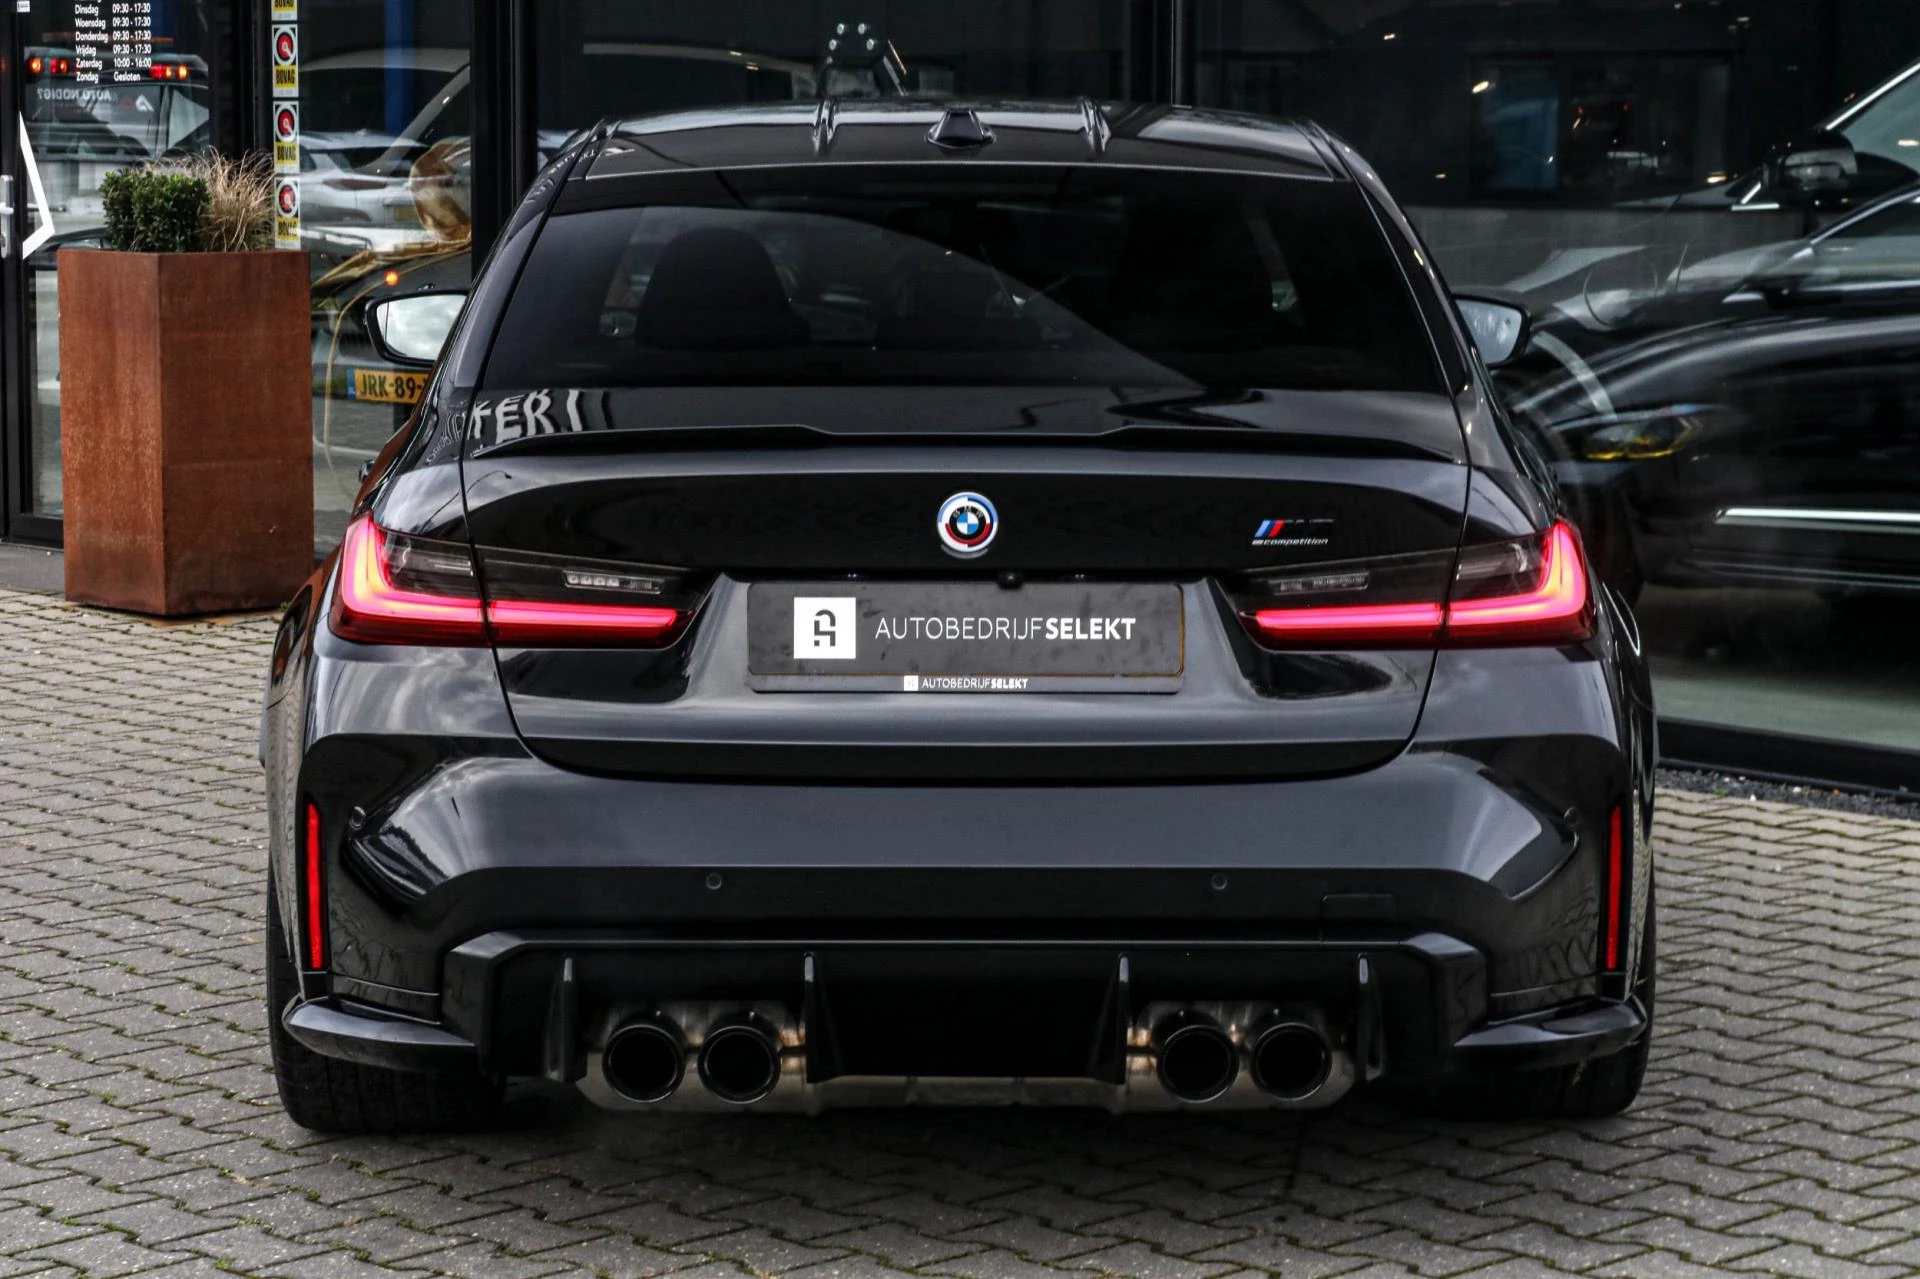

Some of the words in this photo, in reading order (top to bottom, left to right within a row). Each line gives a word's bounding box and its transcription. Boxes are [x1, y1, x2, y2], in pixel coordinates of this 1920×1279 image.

[75, 4, 99, 16] Dinsdag
[112, 3, 129, 14] 09:30
[134, 3, 151, 13] 17:30
[75, 18, 106, 30] Woensdag
[112, 17, 129, 27] 09:30
[134, 17, 151, 27] 17:30
[75, 31, 109, 43] Donderdag
[112, 30, 130, 41] 09:30
[134, 30, 151, 40] 17:30
[75, 44, 97, 57] Vrijdag
[113, 44, 130, 54] 09:30
[135, 44, 152, 54] 17:30
[76, 58, 103, 70] Zaterdag
[113, 58, 130, 68] 10:00
[135, 58, 152, 68] 16:00
[76, 72, 99, 84] Zondag
[113, 71, 141, 81] Gesloten
[276, 68, 295, 84] BOVAG
[277, 145, 296, 160] BOVAG
[874, 616, 1137, 640] AUTOBEDRIJFSELEKT
[921, 677, 1029, 690] AUTOBEDRIJFSELEKT
